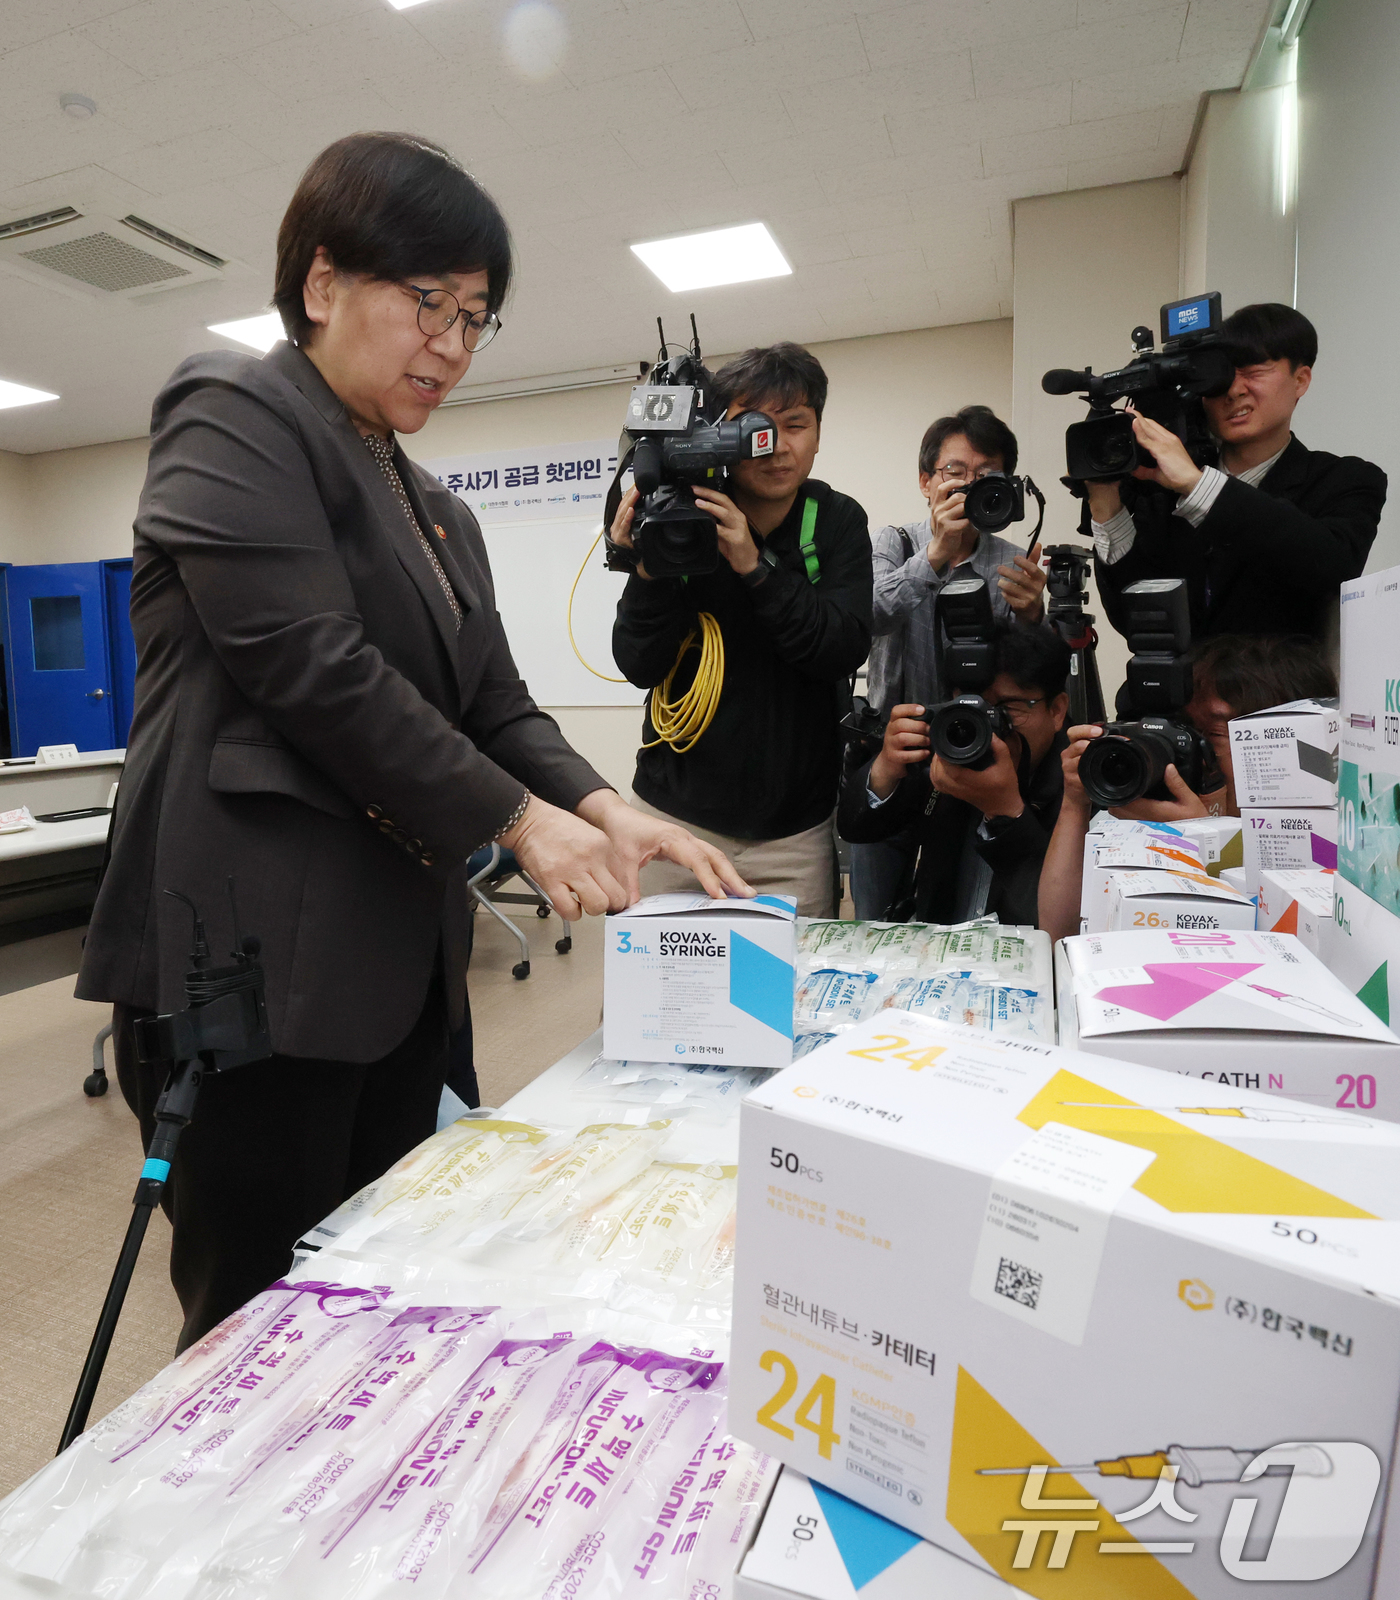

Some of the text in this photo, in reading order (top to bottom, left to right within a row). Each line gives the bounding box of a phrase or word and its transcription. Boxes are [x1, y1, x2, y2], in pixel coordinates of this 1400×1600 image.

[1178, 307, 1198, 318] MBC
[1178, 314, 1198, 324] NEWS
[1103, 371, 1121, 379] SONY
[447, 458, 601, 493] 주사기 공급 핫라인
[1250, 818, 1272, 829] 17G
[1132, 911, 1218, 928] 26G KOVAX-
[616, 931, 717, 955] 3mL KOVAX-
[659, 944, 726, 957] SYRINGE
[1167, 932, 1236, 946] 20
[688, 1045, 724, 1055] (주)한국백신
[845, 1033, 949, 1072] 24
[1268, 1073, 1284, 1089] N
[1335, 1074, 1377, 1109] 20
[769, 1147, 824, 1184] 50PCS
[629, 1215, 647, 1238] SET
[1224, 1294, 1355, 1359] (주)한국백신
[210, 1314, 296, 1395] INFUSION
[327, 1342, 415, 1430] 수액세트
[173, 1399, 212, 1432] SET
[756, 1349, 841, 1461] 24
[560, 1382, 625, 1491] INFUSION
[170, 1429, 234, 1490] CODE K203T
[567, 1402, 643, 1507] 수액세트
[298, 1457, 354, 1522] CODE K203T
[381, 1474, 416, 1510] SET
[672, 1443, 735, 1554] 수액세트
[406, 1500, 455, 1583] CODE K203T
[579, 1532, 606, 1565] CODE
